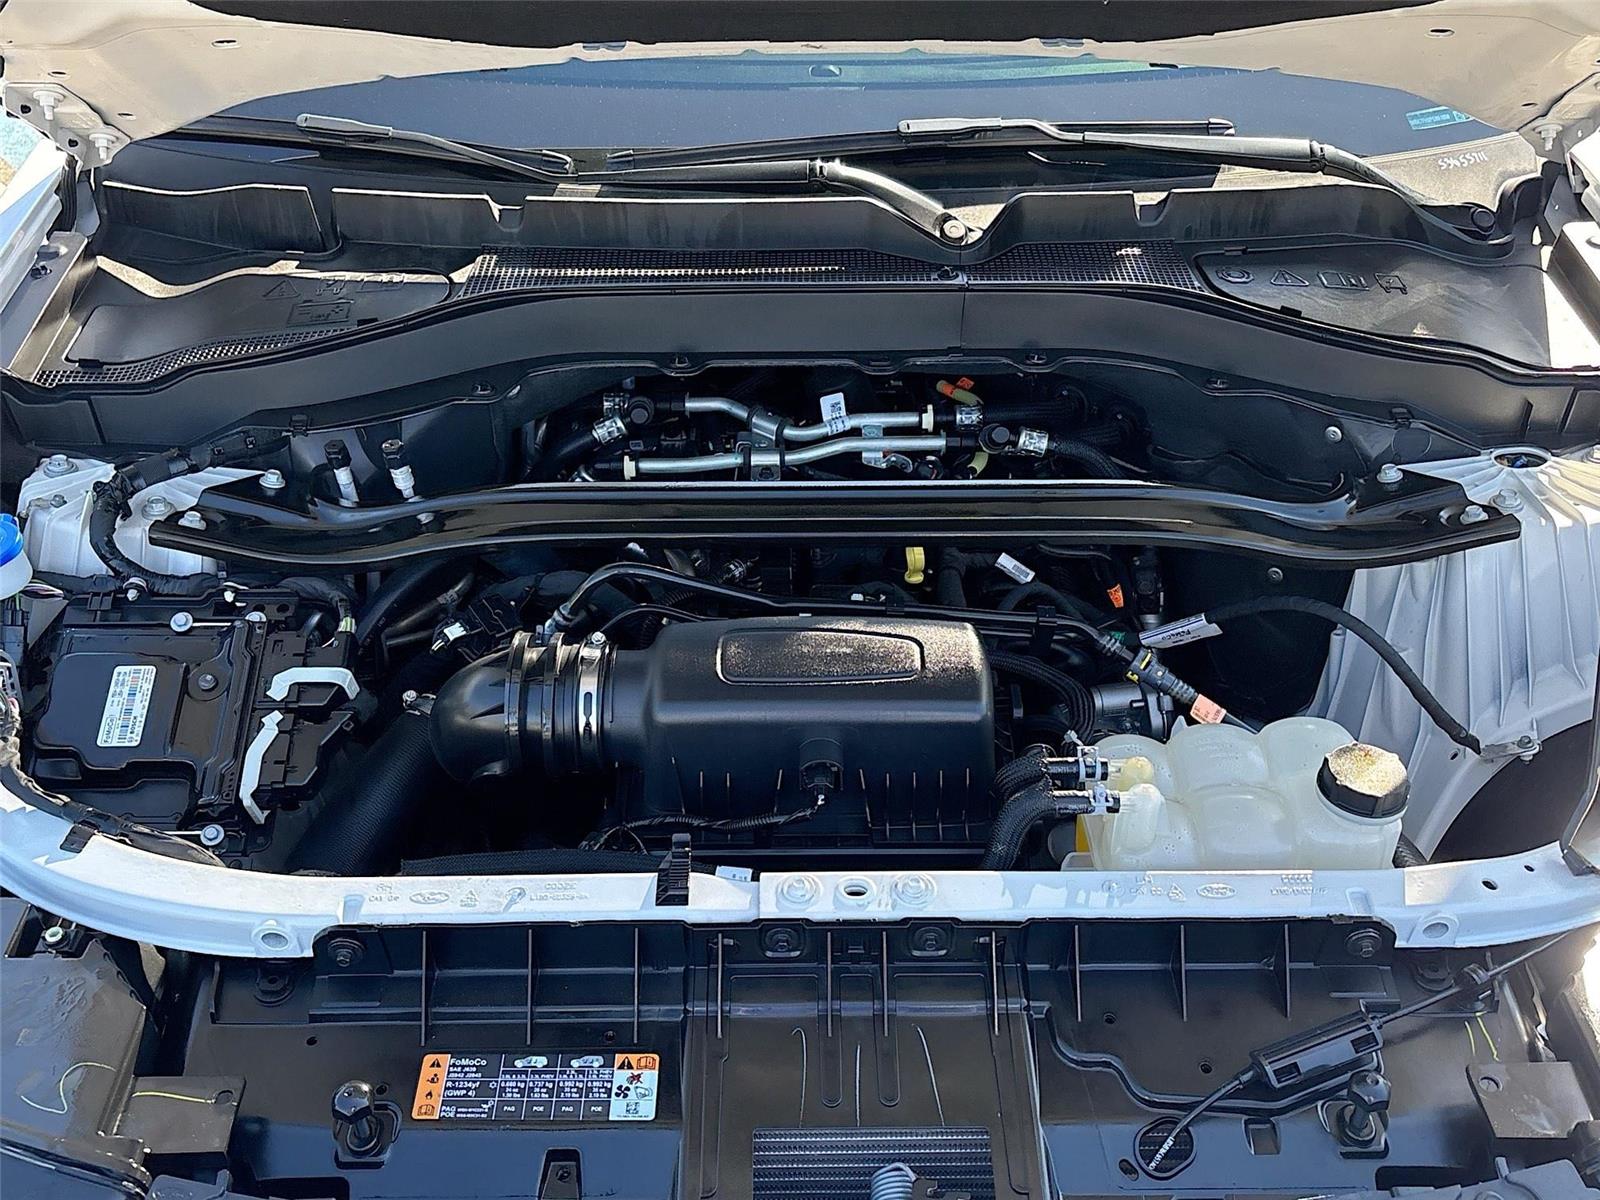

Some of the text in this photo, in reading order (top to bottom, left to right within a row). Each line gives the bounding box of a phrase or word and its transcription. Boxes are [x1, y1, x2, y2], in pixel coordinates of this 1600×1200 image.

[130, 716, 138, 735] BOSCH
[103, 718, 115, 743] FoMoCo
[450, 1058, 487, 1066] FoMoCo
[446, 1081, 480, 1089] R-1234yf
[517, 1081, 525, 1089] kg
[545, 1081, 553, 1089] kg
[604, 1081, 612, 1089] kg
[444, 1090, 476, 1098] (GWP 4)
